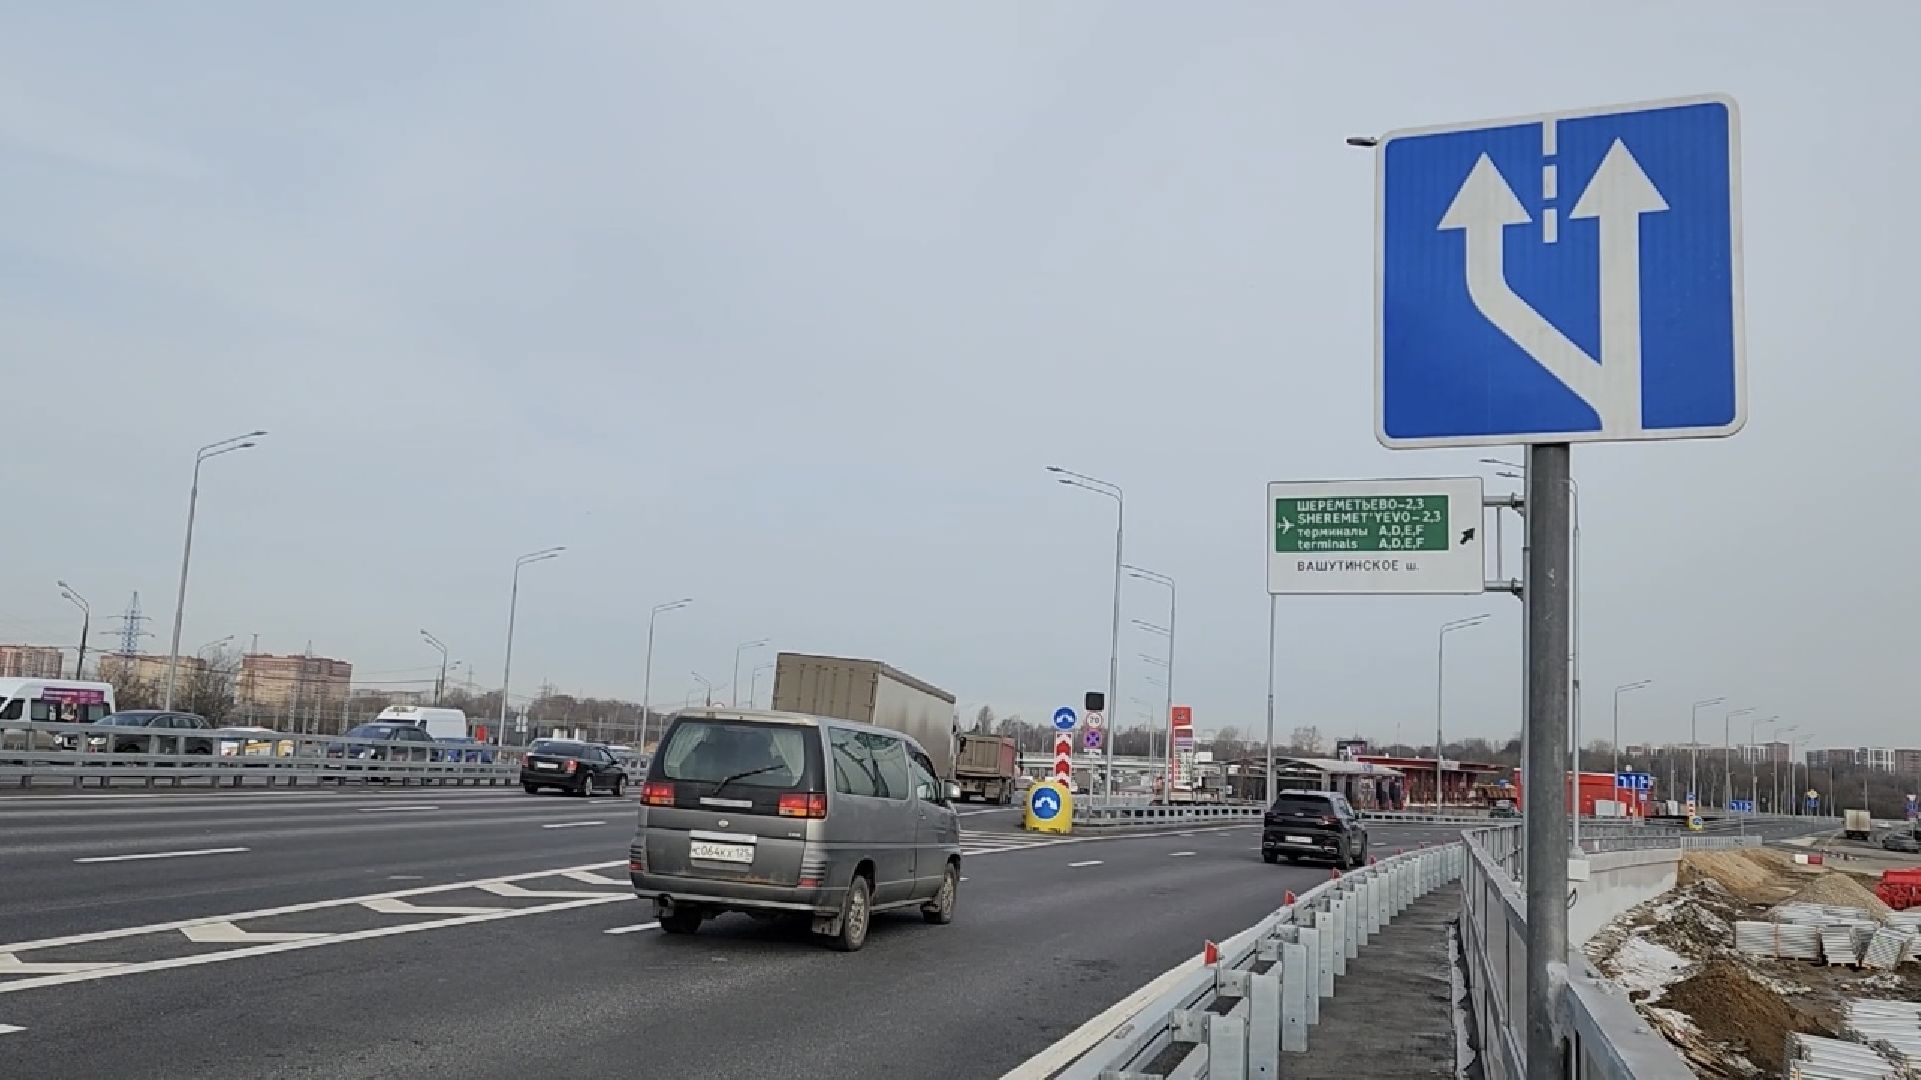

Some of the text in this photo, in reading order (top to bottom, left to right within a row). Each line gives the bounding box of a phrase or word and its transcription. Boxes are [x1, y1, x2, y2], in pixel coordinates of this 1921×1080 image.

[1297, 528, 1368, 540] терминалы
[1297, 538, 1359, 550] terminals
[1297, 559, 1419, 572] ВАШУТИНСКОЕ ш.
